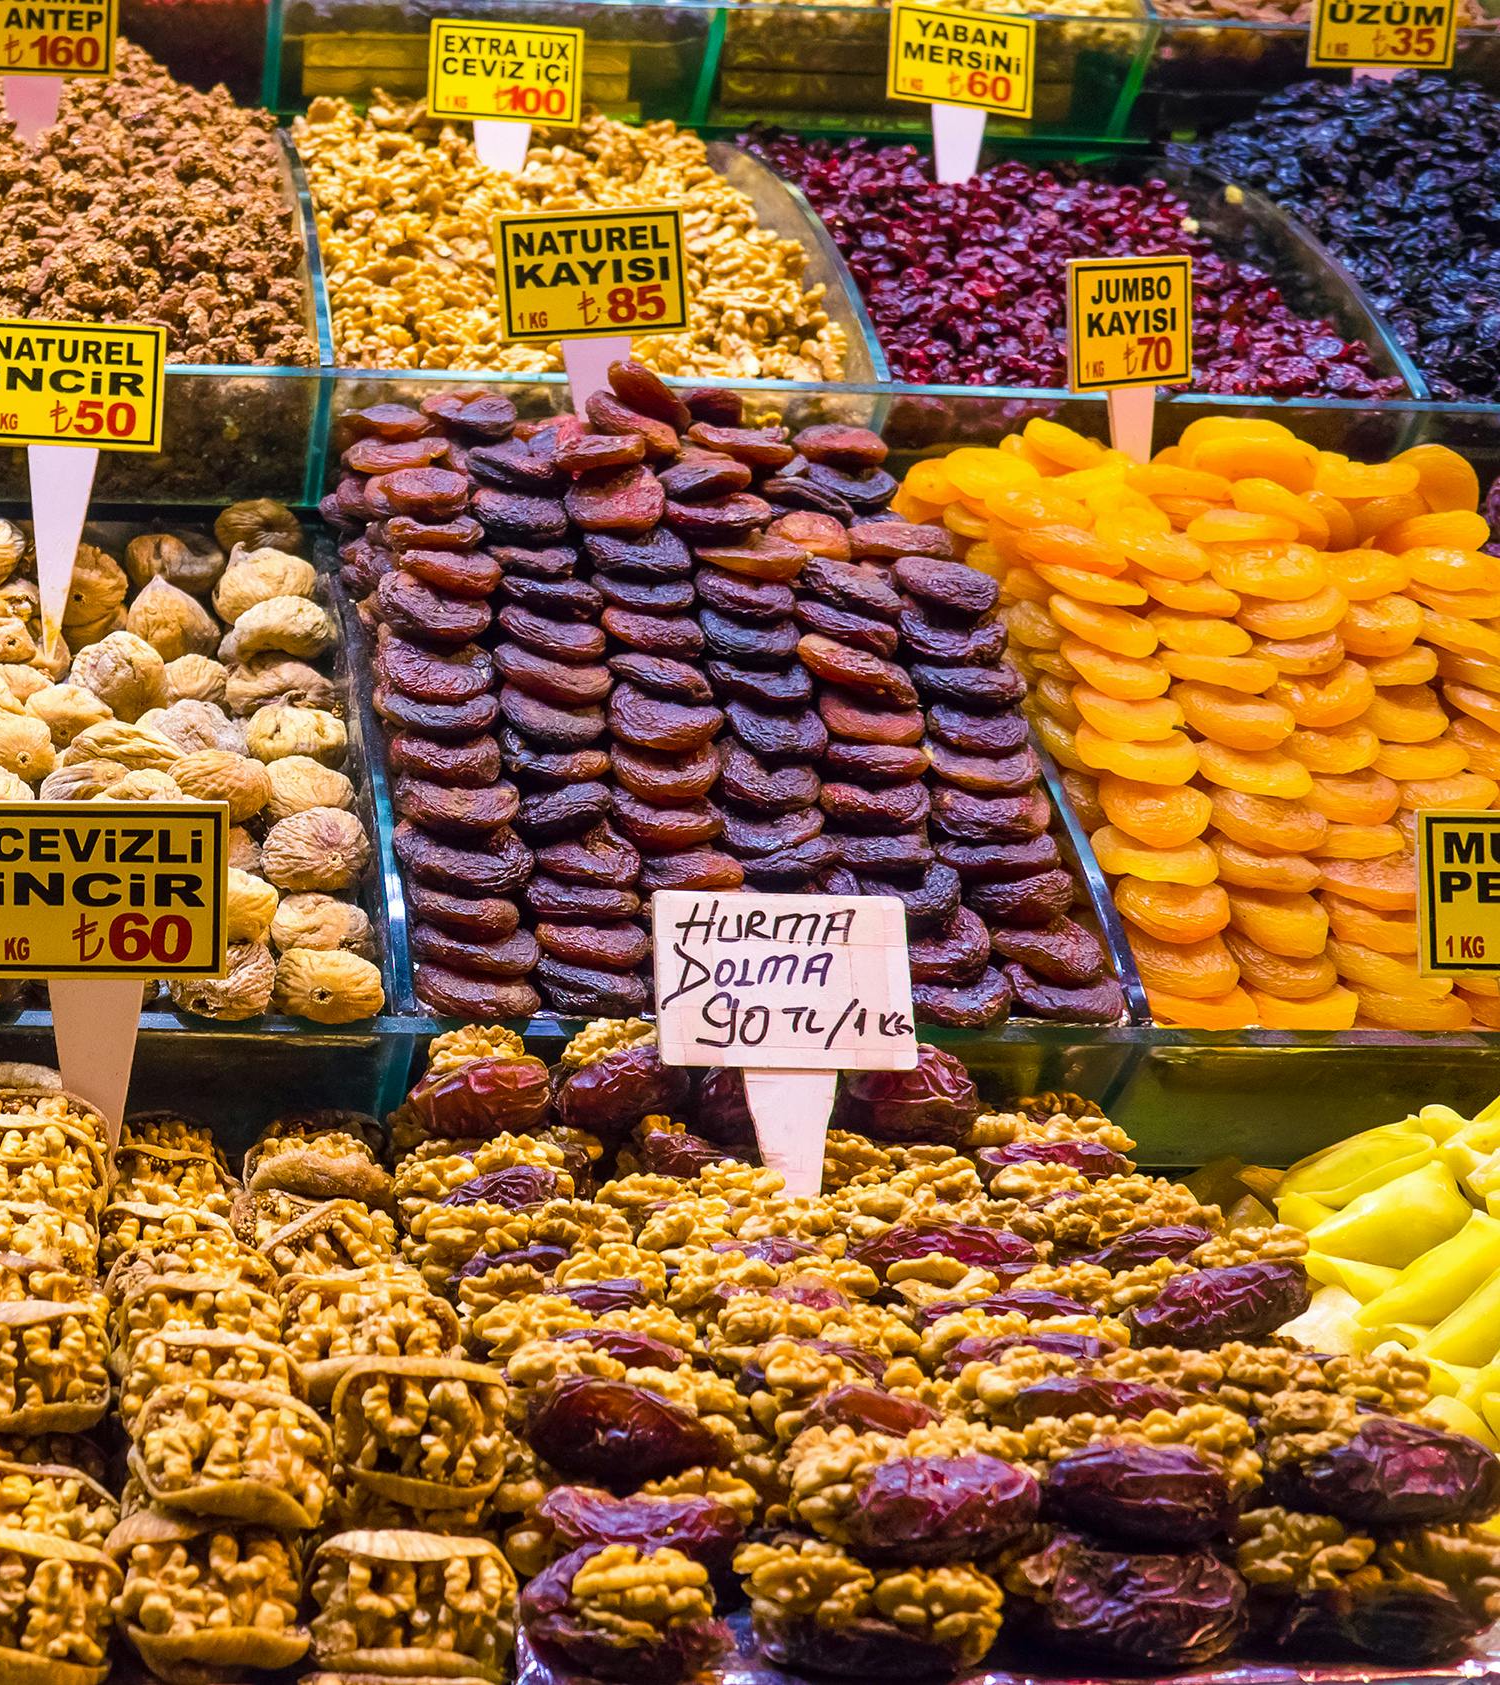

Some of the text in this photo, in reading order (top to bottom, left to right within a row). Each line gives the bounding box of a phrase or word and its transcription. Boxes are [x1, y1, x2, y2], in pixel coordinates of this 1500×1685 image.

[4, 7, 103, 32] ANTEP
[916, 19, 1008, 50] YABAN
[444, 35, 518, 57] EXTRA
[512, 225, 670, 258] NATUREL
[514, 256, 671, 290] KAYISI
[1091, 275, 1172, 305] JUMBO
[1086, 307, 1177, 339] KAYISI
[674, 899, 857, 948] HURMA
[694, 991, 771, 1049] 90
